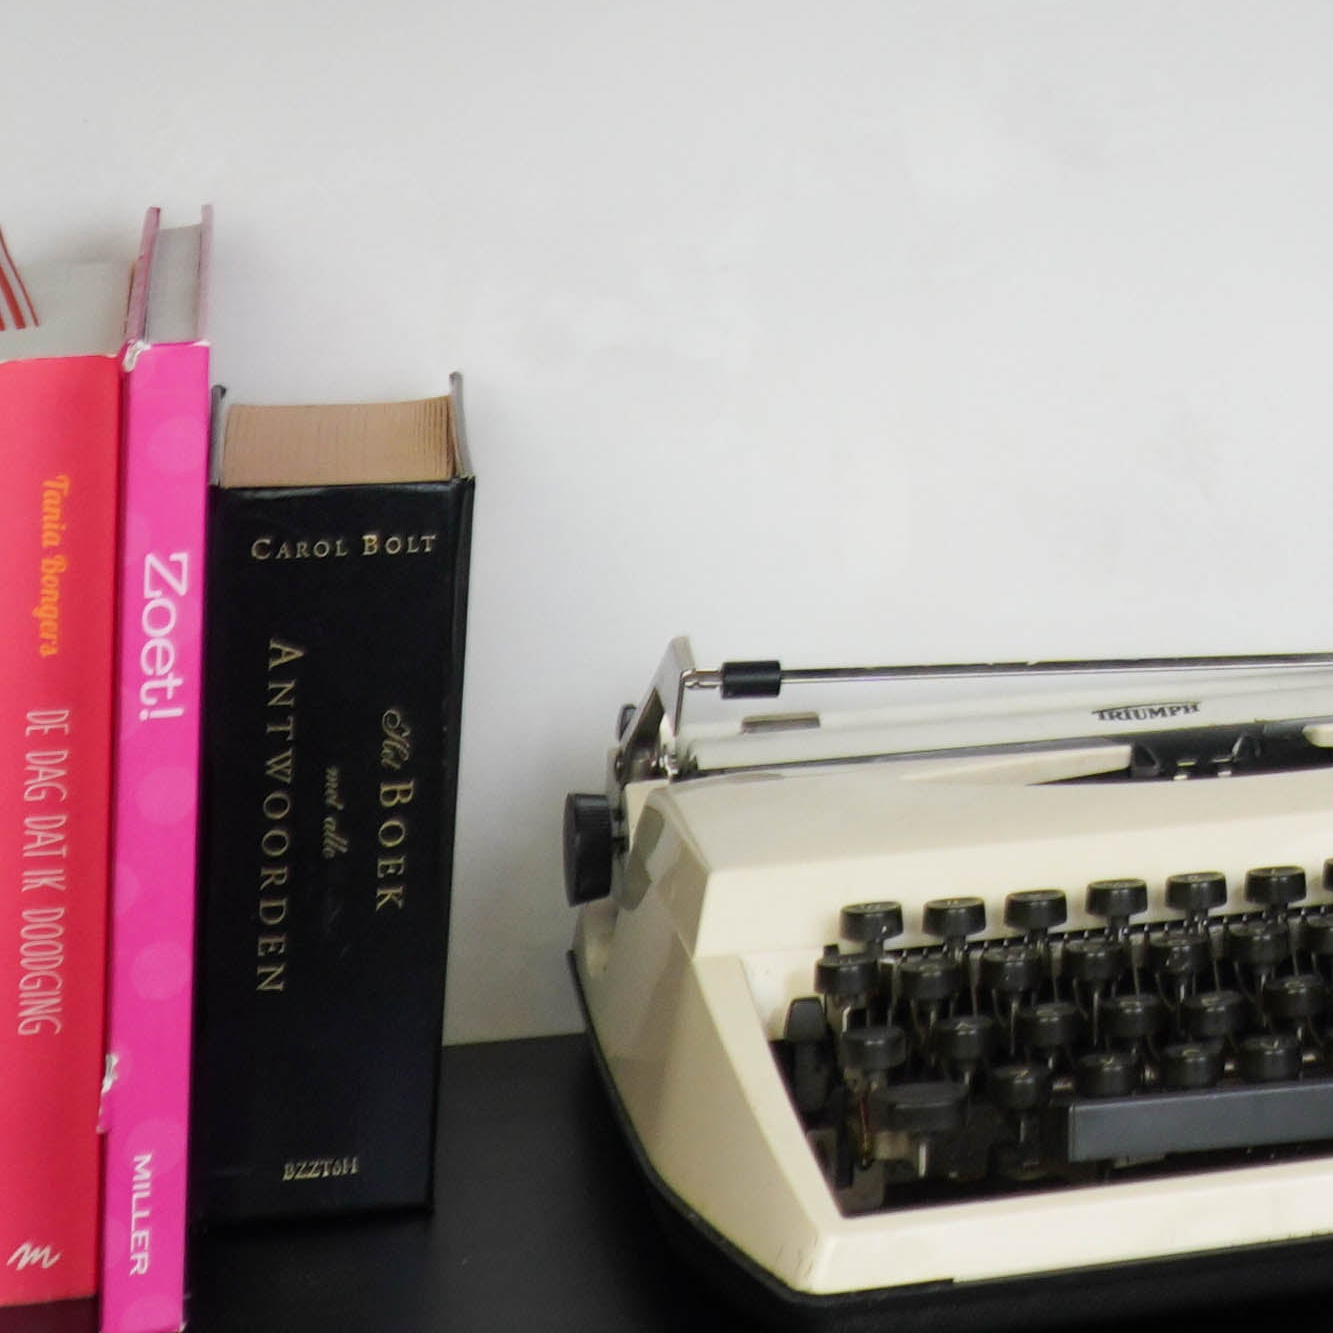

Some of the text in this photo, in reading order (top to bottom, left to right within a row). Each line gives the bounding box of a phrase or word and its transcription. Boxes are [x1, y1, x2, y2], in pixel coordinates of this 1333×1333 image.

[32, 473, 70, 658] Tania Bongers
[138, 552, 189, 722] Zoet!
[1091, 701, 1202, 721] TRIUMPH
[17, 709, 71, 1037] DE DAG DAT IK DOODGING
[255, 637, 304, 993] ANTWOORDEN
[322, 764, 350, 861] met alle
[375, 707, 415, 913] Het BOEK
[128, 1153, 153, 1277] MILLER
